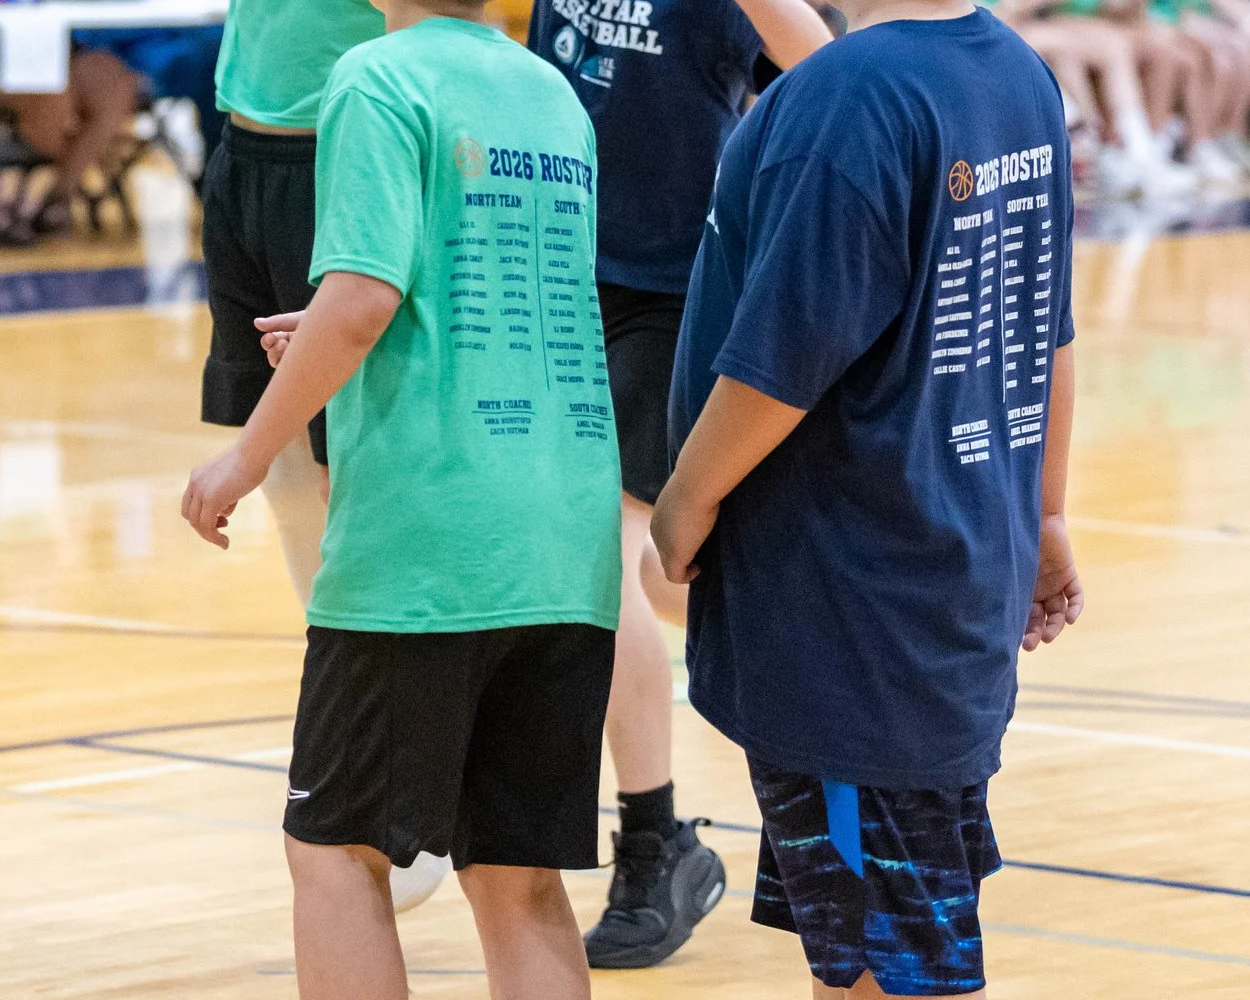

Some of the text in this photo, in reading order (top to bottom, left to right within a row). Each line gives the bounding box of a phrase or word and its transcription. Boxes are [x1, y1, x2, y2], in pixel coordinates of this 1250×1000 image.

[489, 147, 534, 181] 2026
[975, 144, 1053, 197] 2026 ROSTER
[464, 193, 522, 209] NORTH TEAM
[554, 200, 580, 215] SOUTH
[1006, 196, 1034, 214] SOUTH
[953, 213, 982, 231] NORTH
[569, 403, 590, 413] SOUTH
